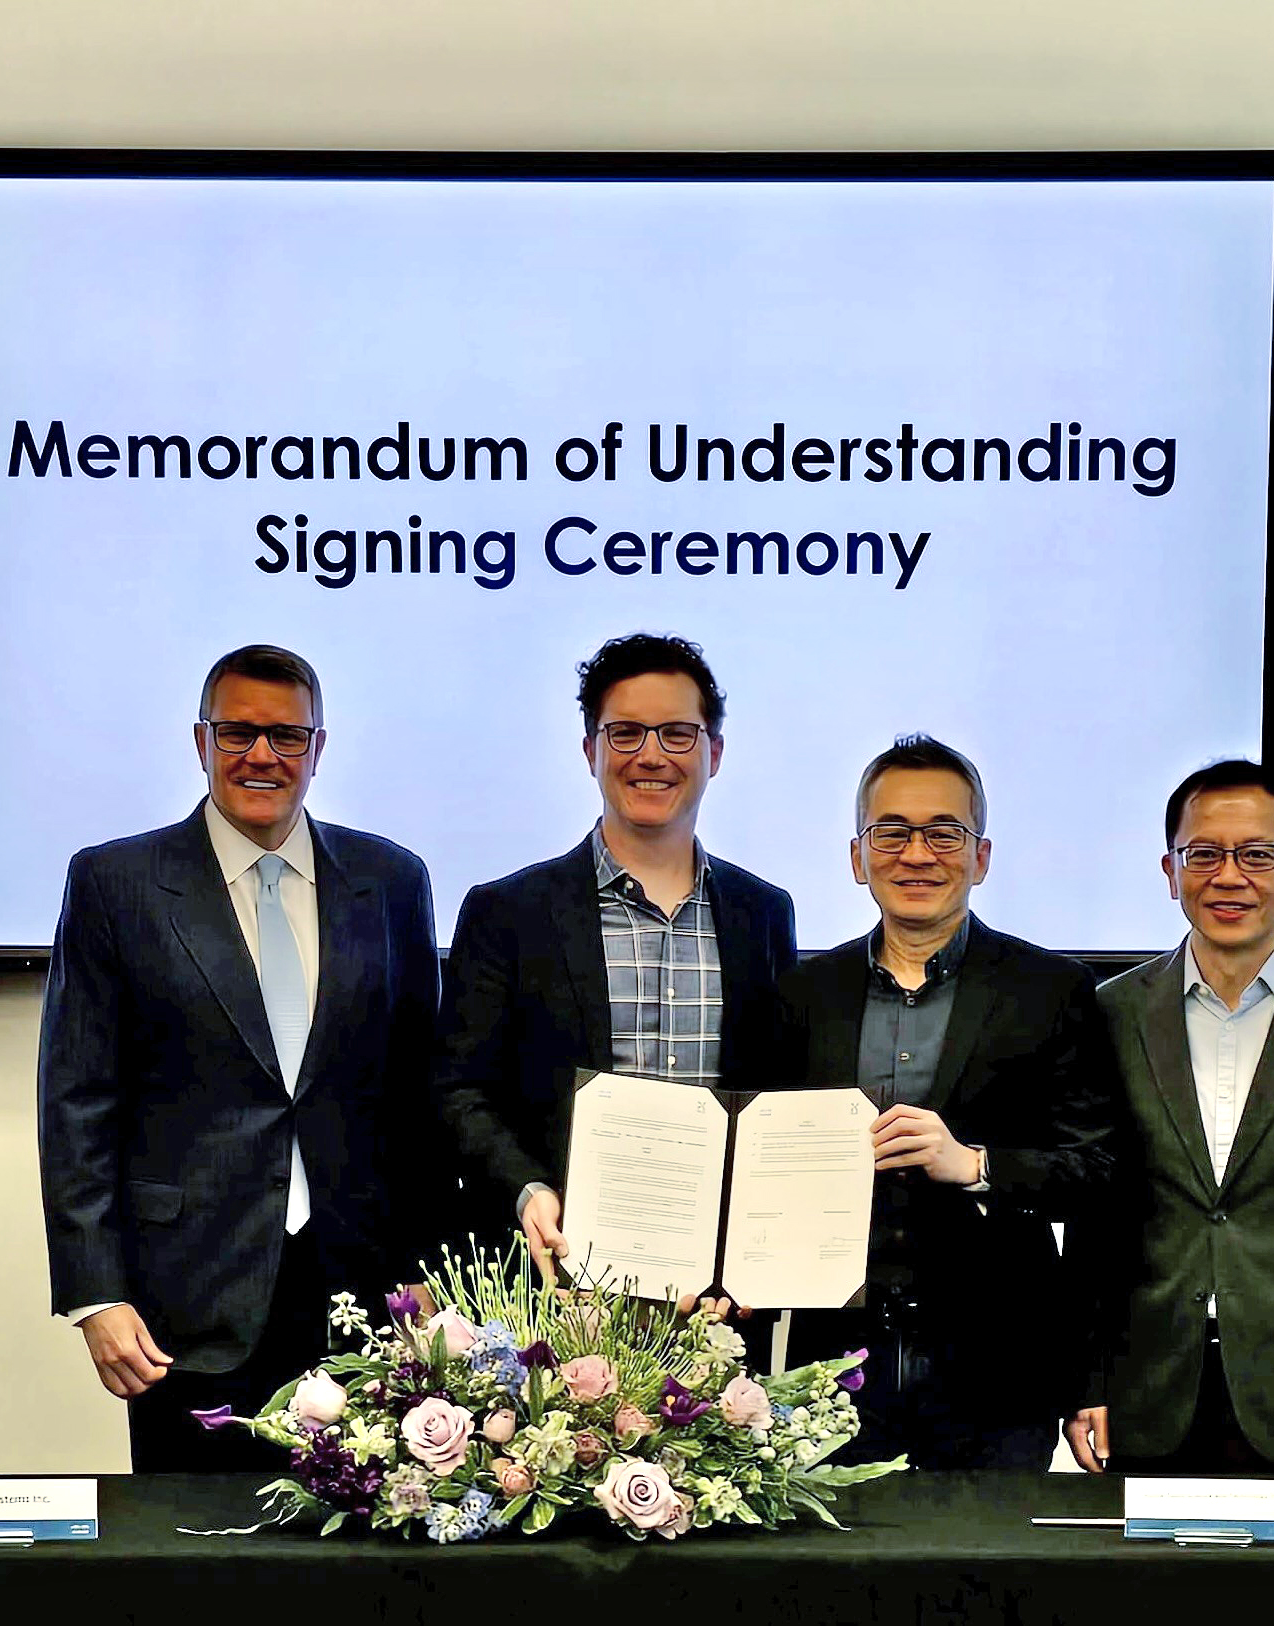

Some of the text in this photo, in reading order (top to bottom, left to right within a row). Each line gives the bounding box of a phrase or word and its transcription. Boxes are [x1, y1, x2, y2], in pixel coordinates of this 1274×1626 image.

[7, 419, 1178, 498] Memorandum of Understanding
[254, 513, 933, 591] Signing Ceremony
